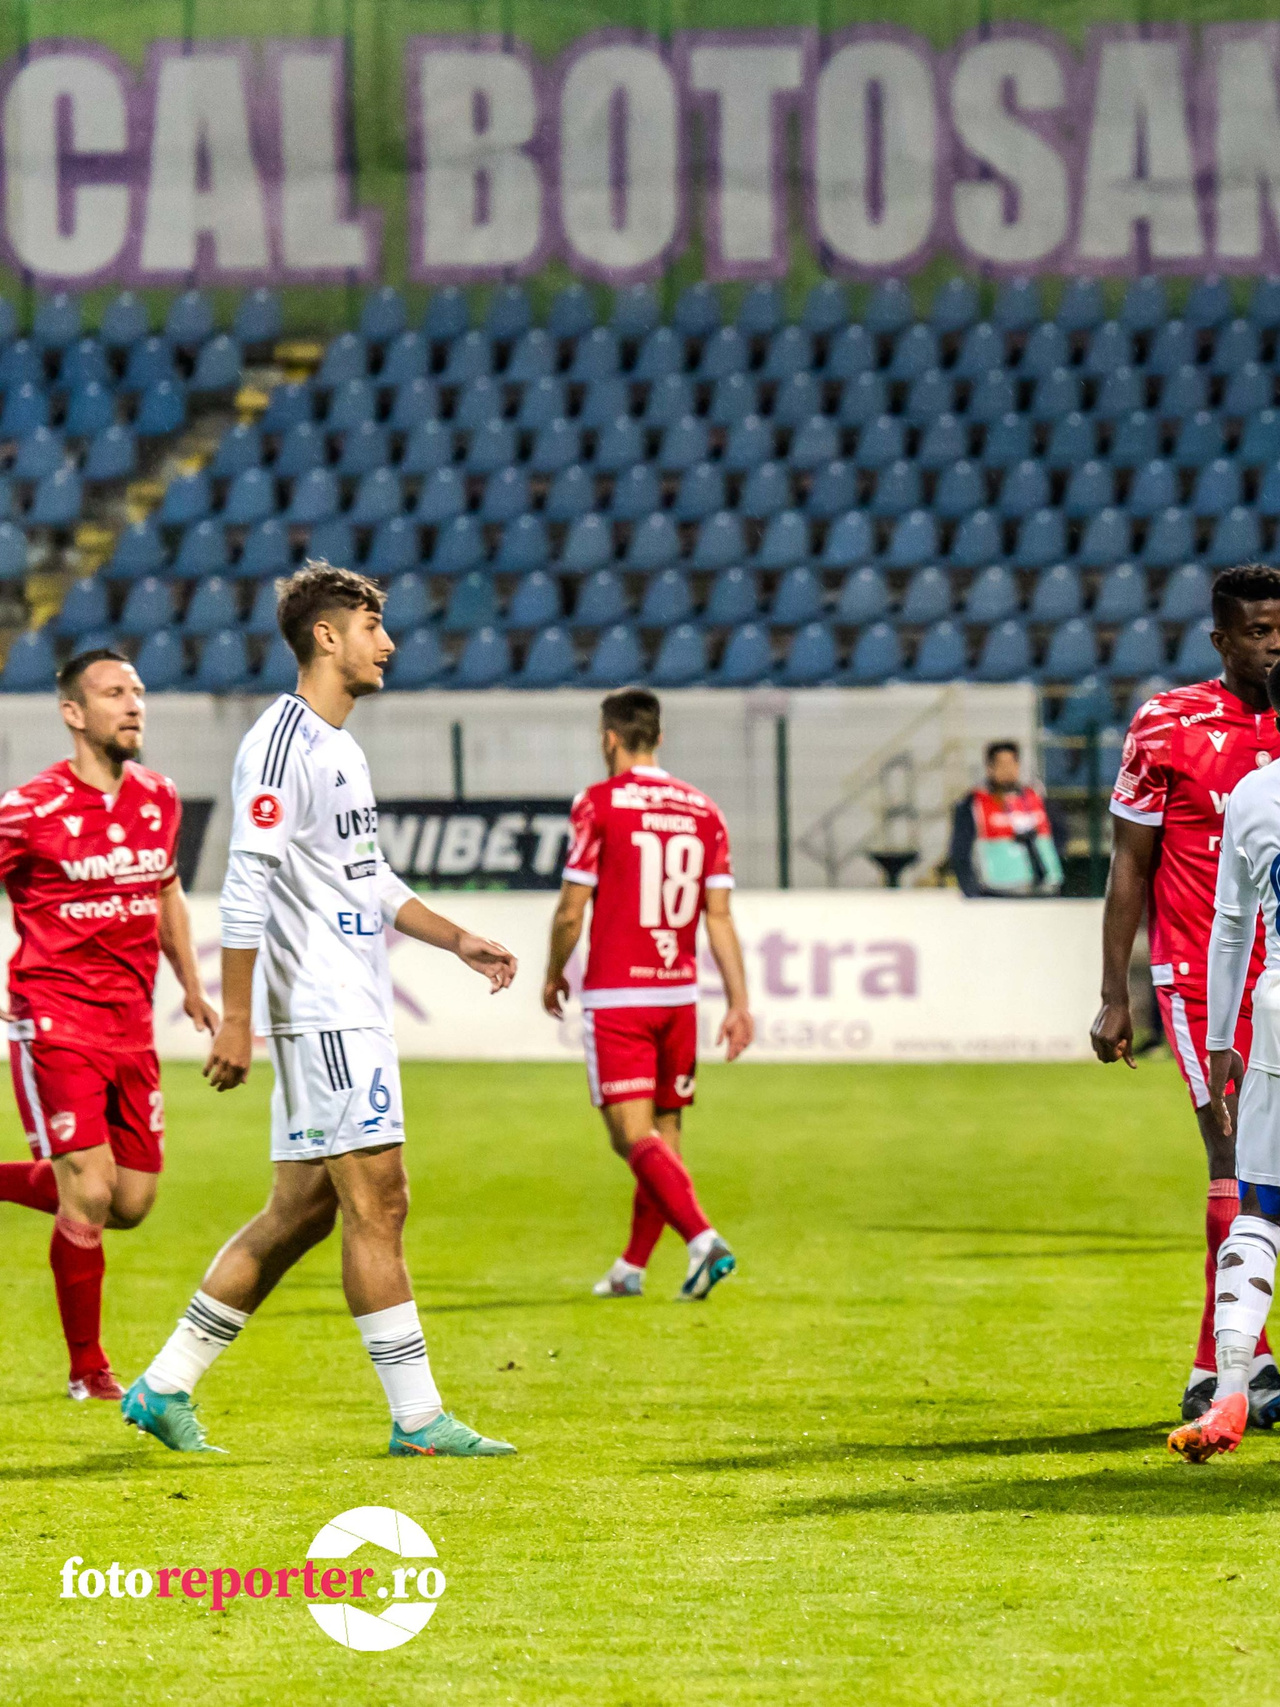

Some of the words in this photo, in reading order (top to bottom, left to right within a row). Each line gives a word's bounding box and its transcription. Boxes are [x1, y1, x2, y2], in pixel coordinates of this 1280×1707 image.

[5, 53, 367, 277] CAL
[630, 831, 705, 928] 18
[369, 1067, 391, 1113] 6
